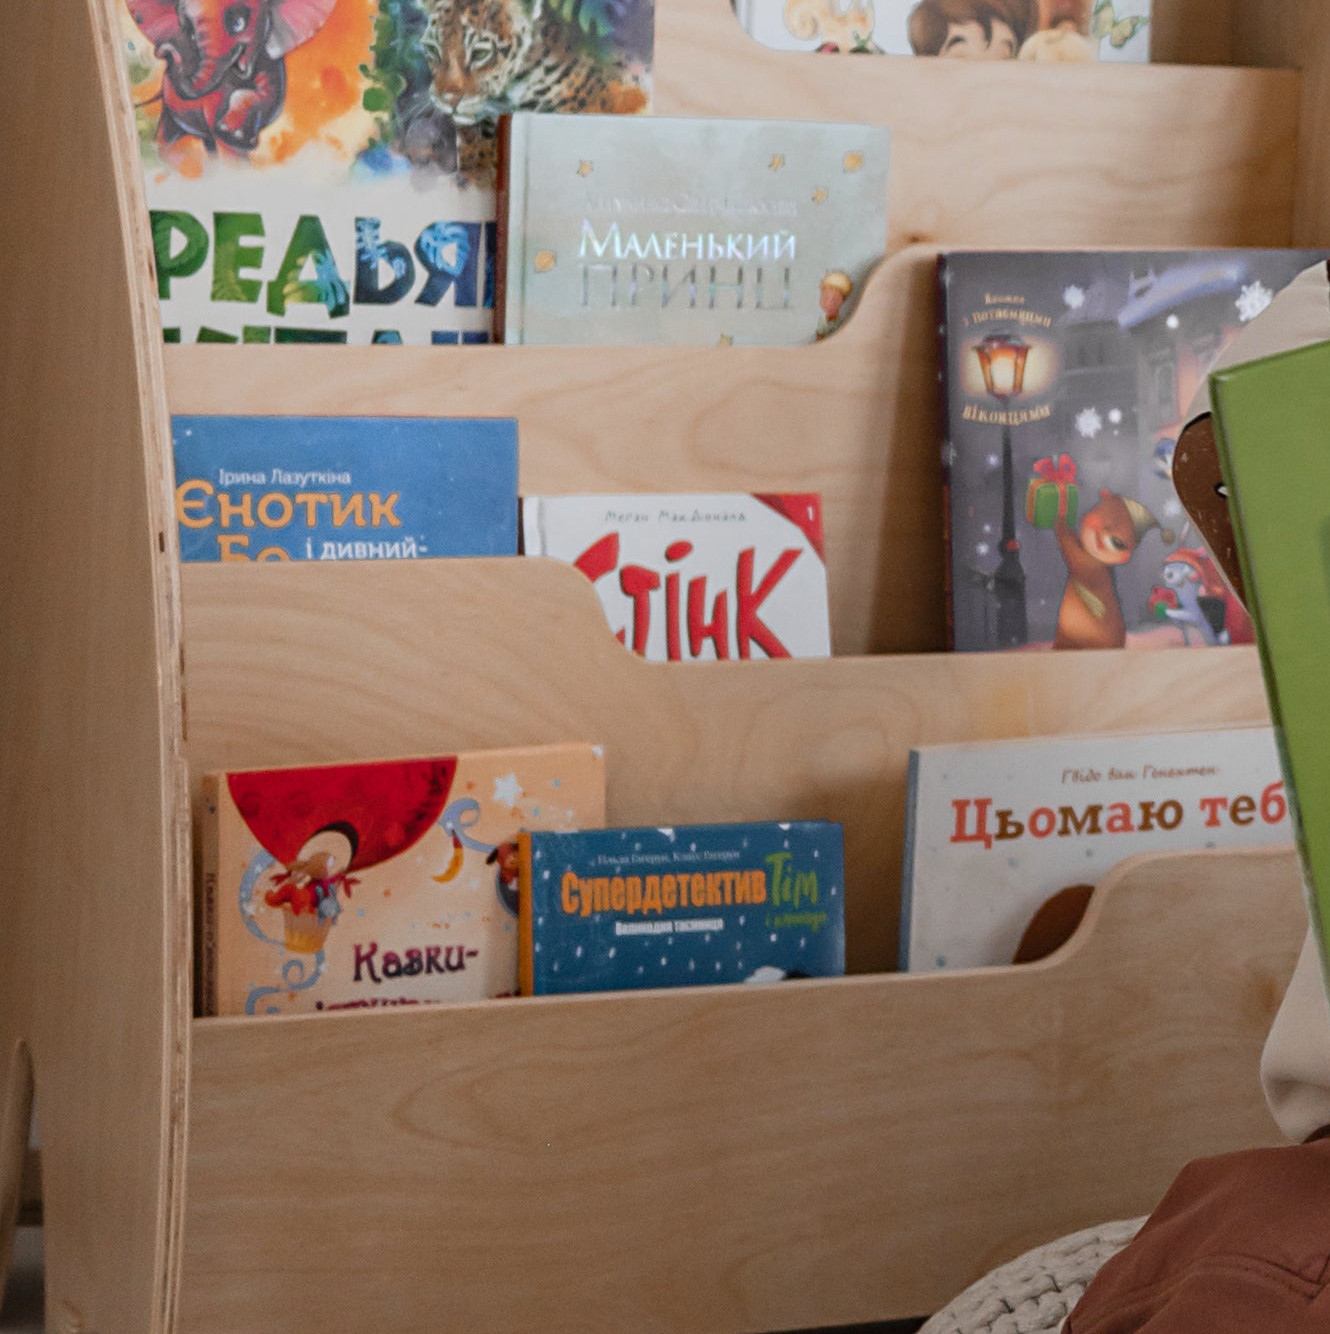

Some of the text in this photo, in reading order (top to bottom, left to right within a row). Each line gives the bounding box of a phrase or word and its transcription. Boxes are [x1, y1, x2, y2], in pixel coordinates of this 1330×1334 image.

[578, 264, 795, 310] ПРИНЦ
[219, 469, 351, 487] Ірина Лазуткіна
[175, 479, 401, 528] Єнотик
[807, 506, 815, 522] 1
[320, 536, 416, 560] дивний
[950, 797, 1184, 849] Цьомаю
[560, 869, 767, 917] Супердетектив
